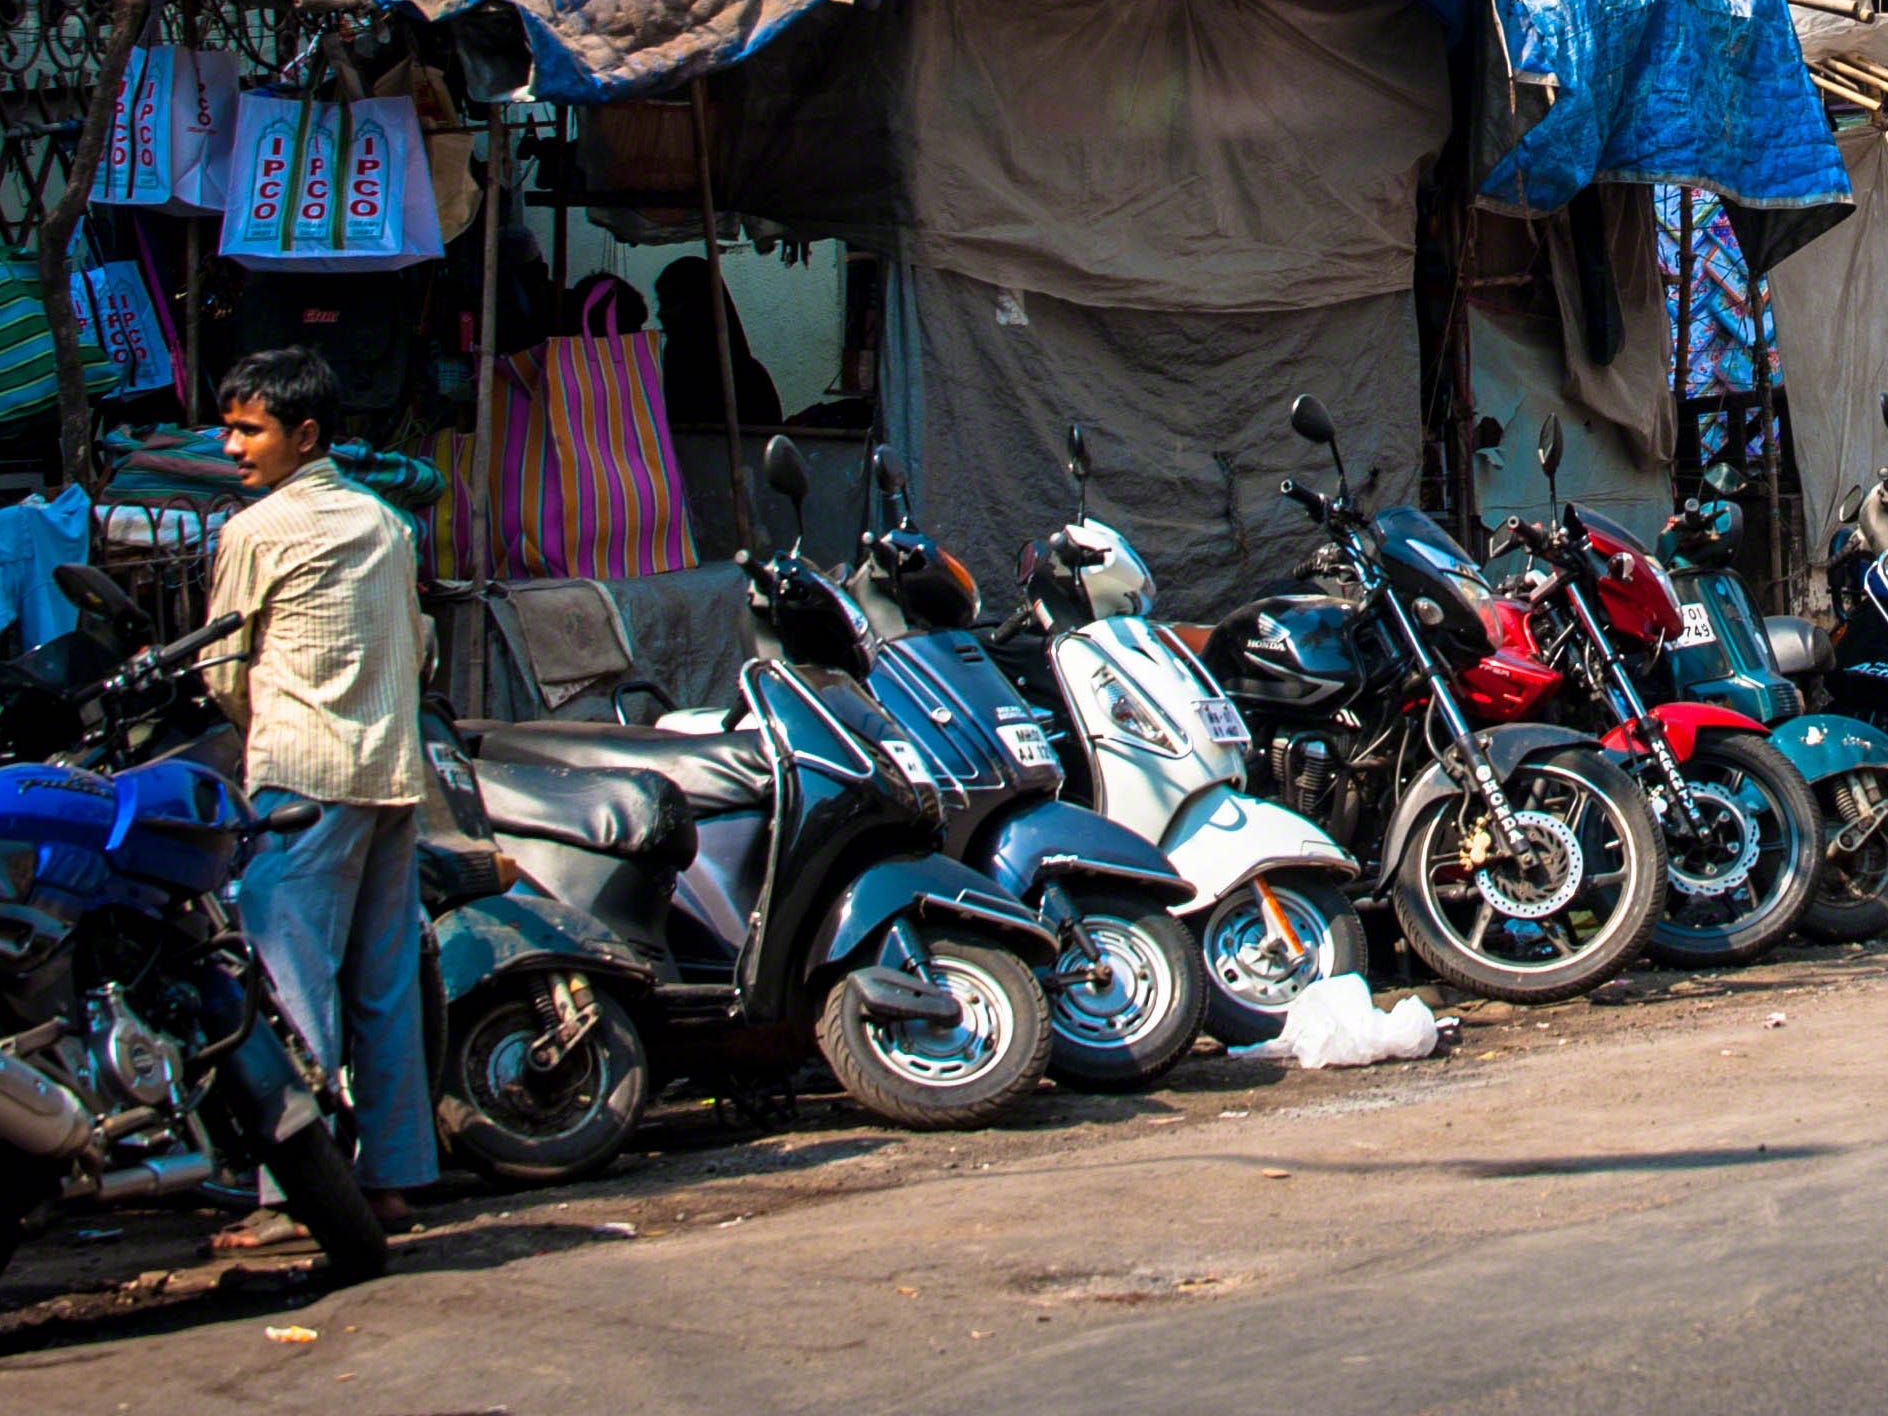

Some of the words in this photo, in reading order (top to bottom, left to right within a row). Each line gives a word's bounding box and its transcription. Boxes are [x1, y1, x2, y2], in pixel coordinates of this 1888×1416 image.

[253, 137, 286, 220] IPCO
[350, 137, 381, 217] IPCO
[1247, 639, 1287, 652] HONDA
[1482, 780, 1525, 844] HONDA
